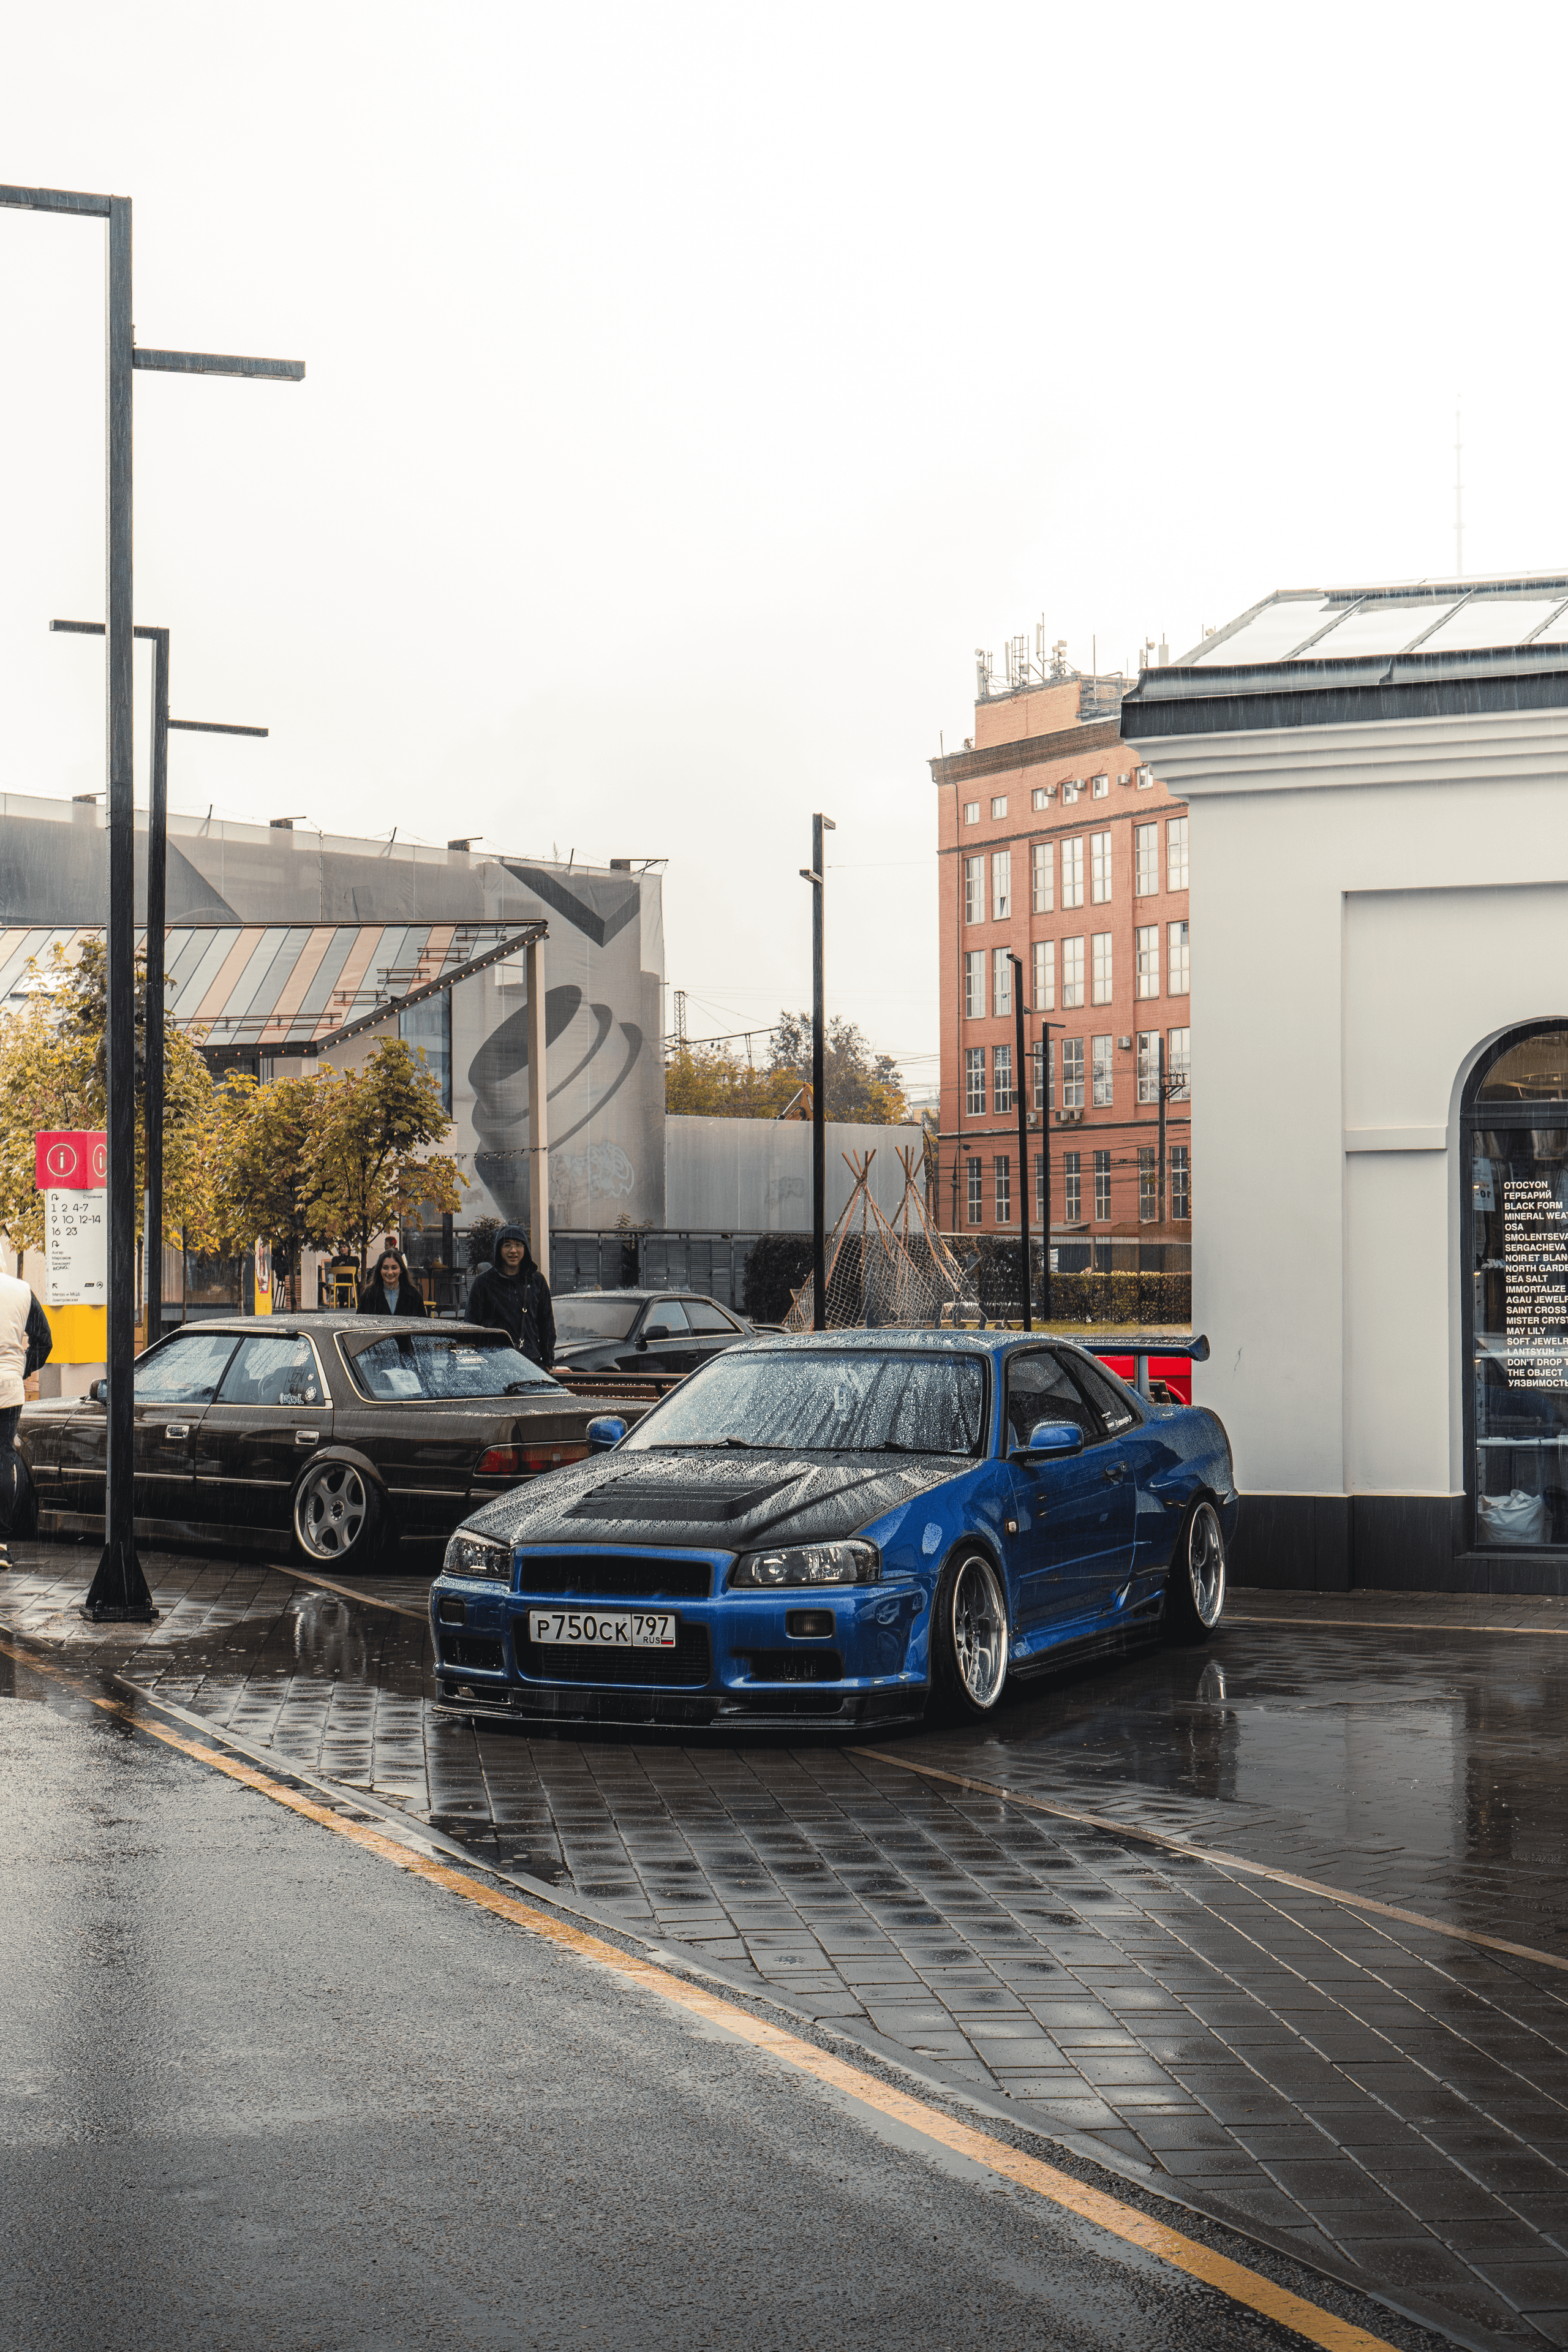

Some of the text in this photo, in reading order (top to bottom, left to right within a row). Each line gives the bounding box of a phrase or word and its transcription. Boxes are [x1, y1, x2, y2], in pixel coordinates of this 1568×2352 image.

[1504, 1181, 1548, 1189] OTOCYON
[1504, 1189, 1551, 1199] ГЕРБАРИЙ
[51, 1204, 88, 1212] 1 2 4-7
[1537, 1201, 1563, 1210] FORM
[51, 1215, 101, 1224] 9 10 12-14
[52, 1227, 78, 1235] 16 23
[1505, 1243, 1566, 1252] SERGACHEVA
[633, 1616, 669, 1636] 797
